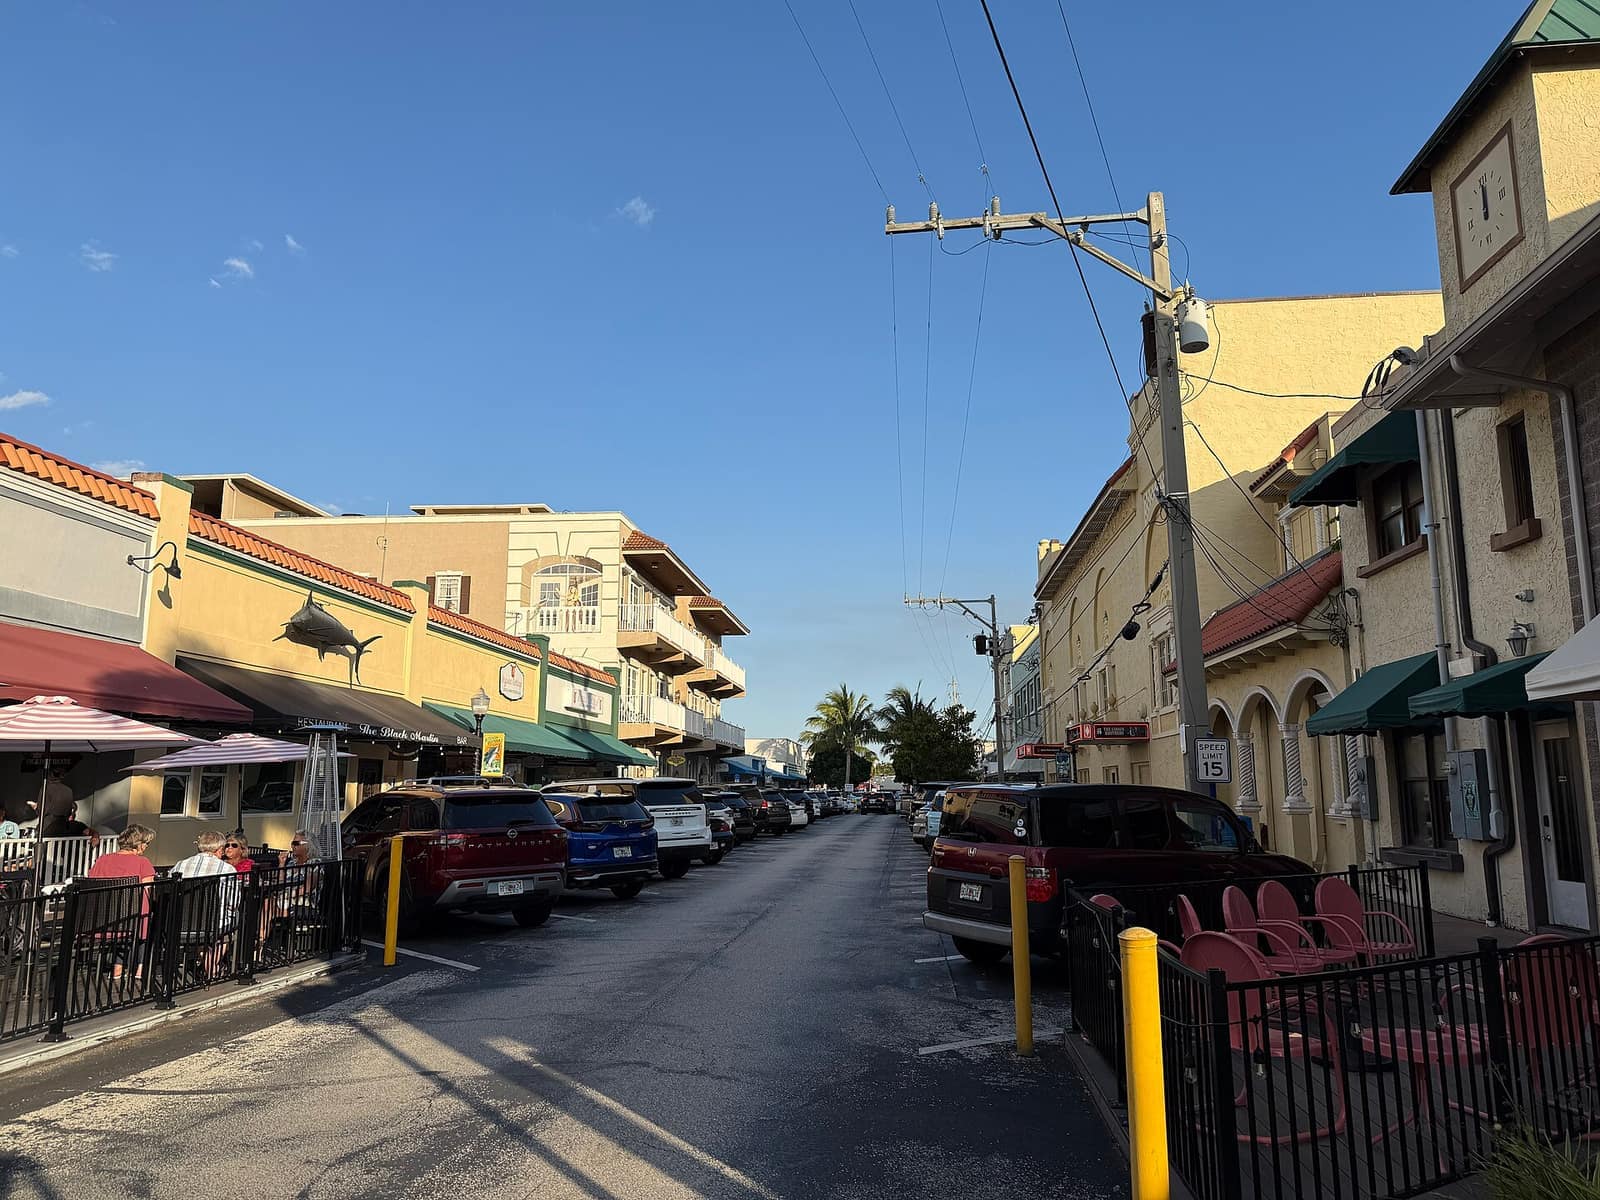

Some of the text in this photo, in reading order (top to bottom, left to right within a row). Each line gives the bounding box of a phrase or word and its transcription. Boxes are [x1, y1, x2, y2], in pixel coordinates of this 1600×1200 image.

[359, 723, 439, 743] The Black Martin
[456, 736, 468, 745] BAR
[1198, 743, 1226, 751] SPEED
[1202, 752, 1223, 760] LIMIT
[1203, 761, 1224, 777] 15
